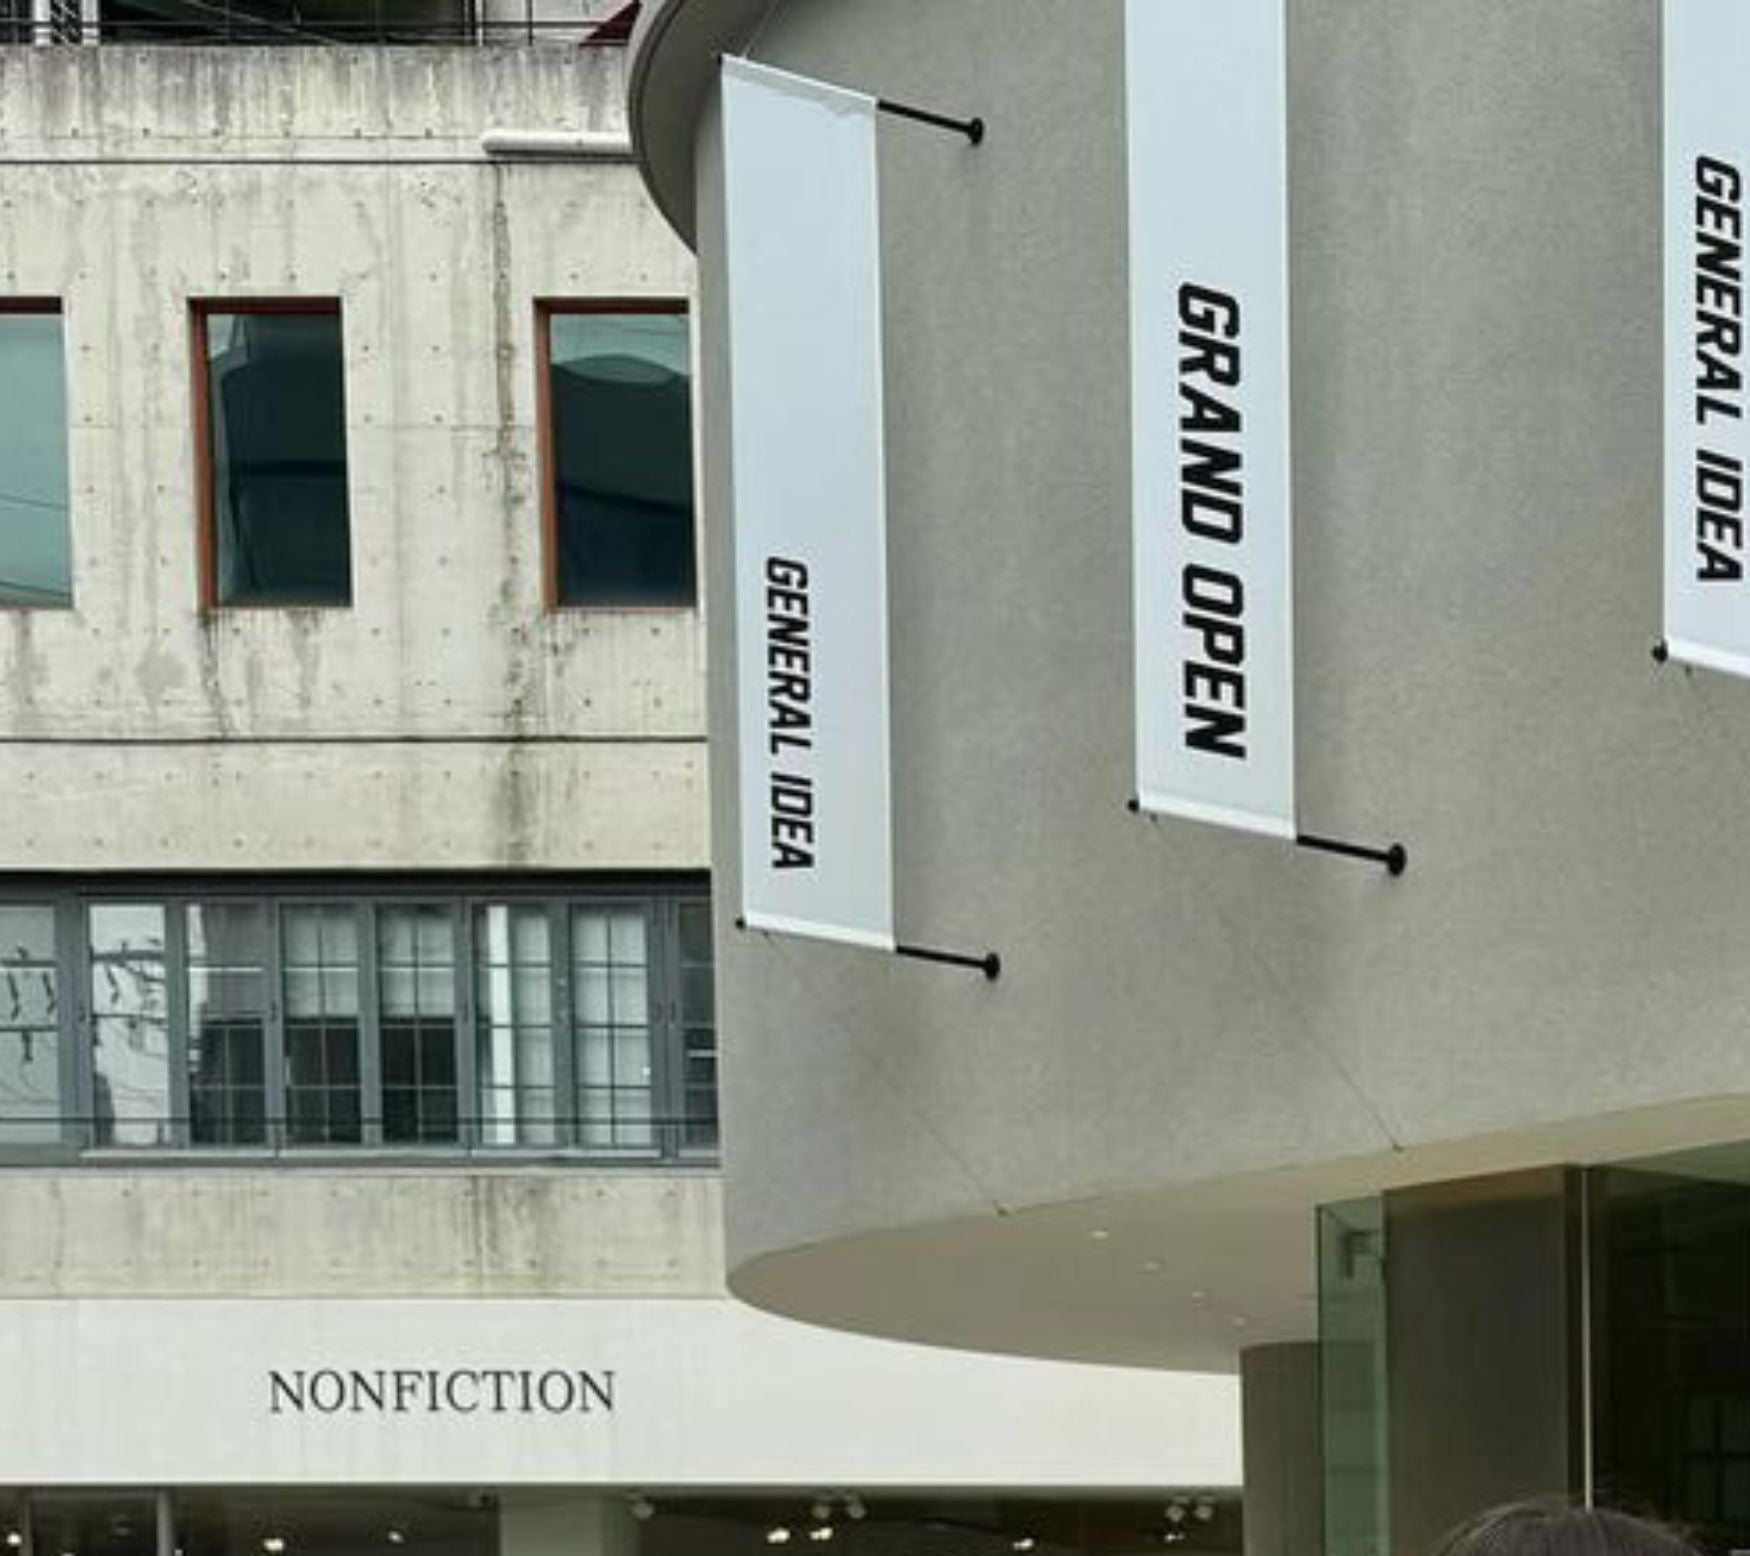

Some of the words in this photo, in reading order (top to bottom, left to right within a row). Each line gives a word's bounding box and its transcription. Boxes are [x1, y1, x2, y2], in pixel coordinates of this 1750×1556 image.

[1695, 155, 1743, 425] GENERAL
[1178, 282, 1243, 544] GRAND
[1696, 449, 1744, 581] IDEA
[766, 556, 812, 755] GENERAL
[1182, 563, 1246, 759] OPEN
[770, 772, 814, 869] IDEA
[269, 1370, 614, 1412] NONFICTION
